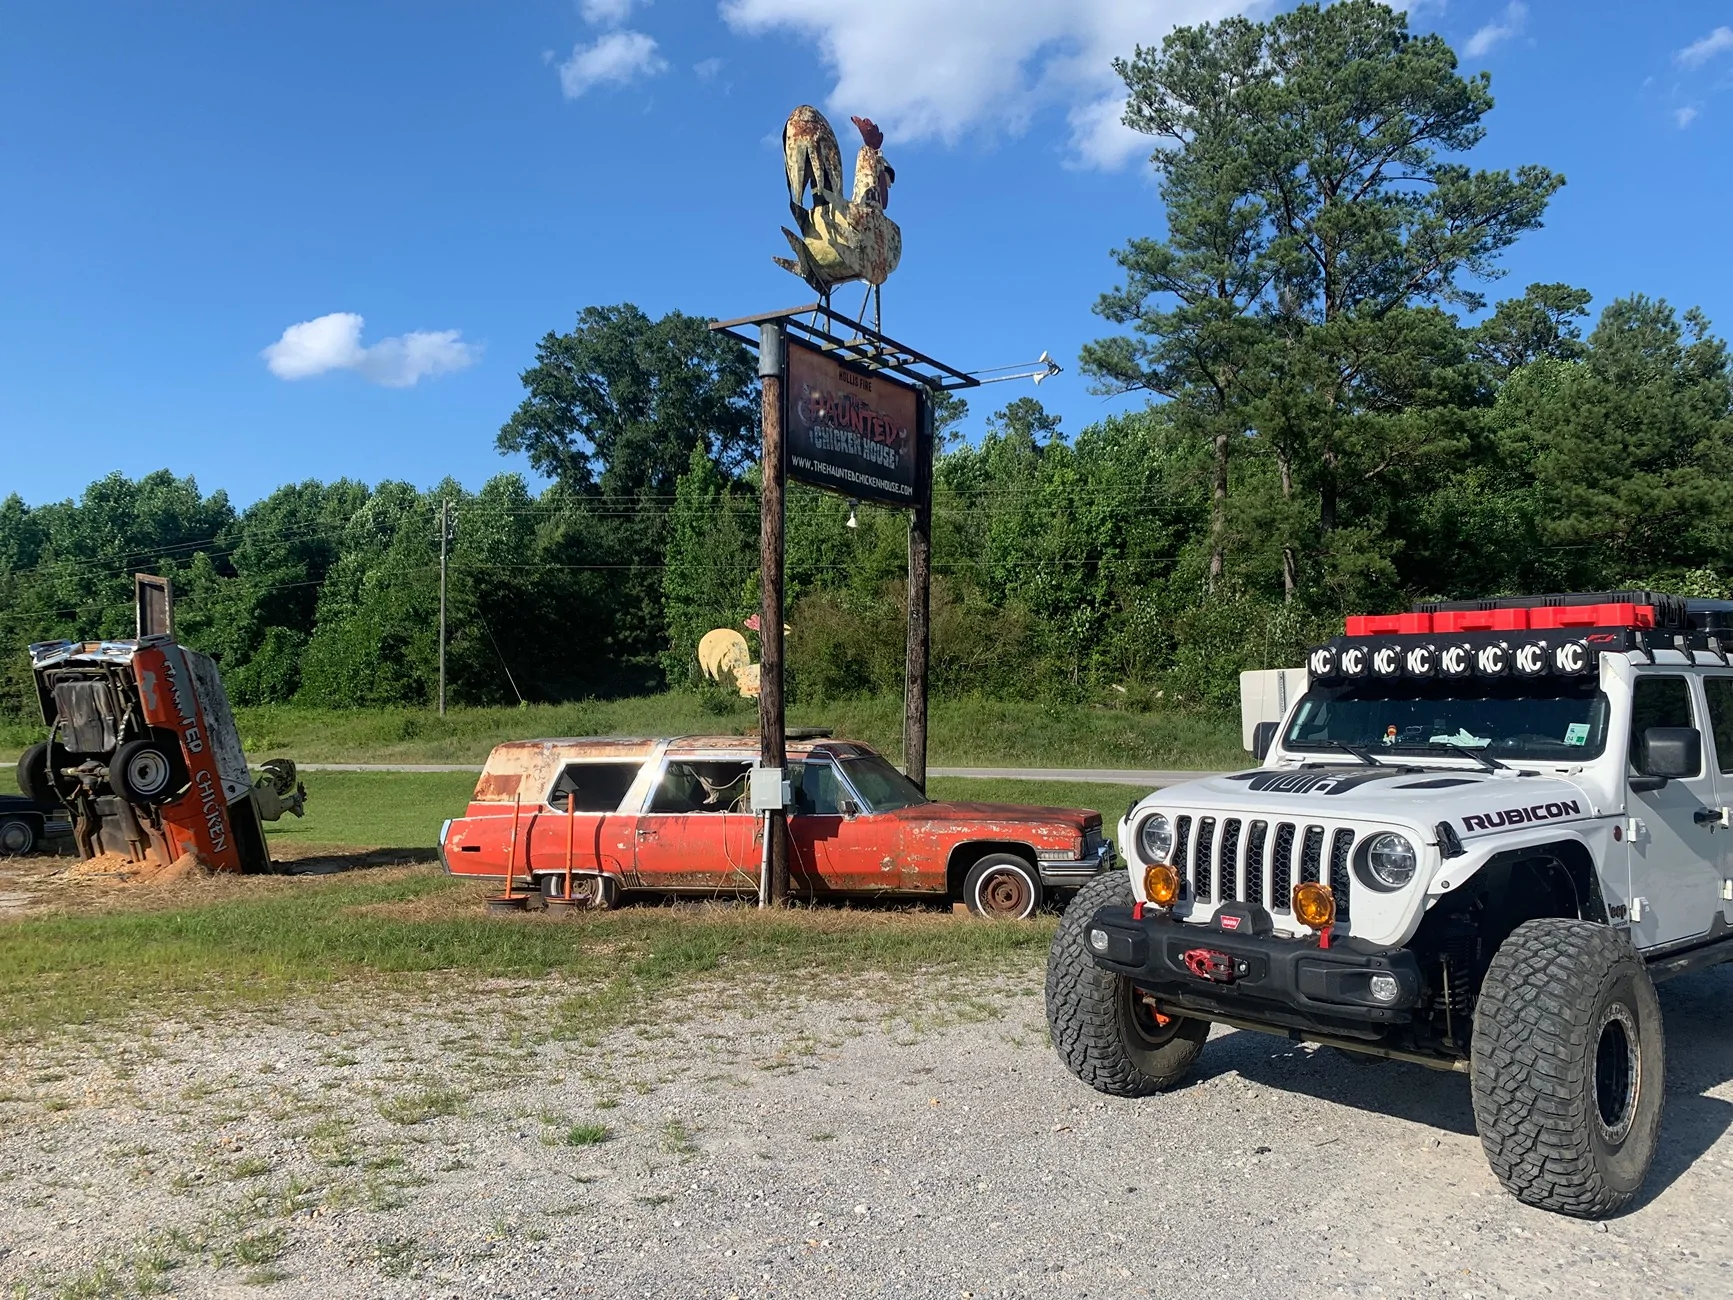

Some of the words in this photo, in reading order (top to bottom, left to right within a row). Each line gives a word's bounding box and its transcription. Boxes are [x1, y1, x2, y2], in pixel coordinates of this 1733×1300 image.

[838, 370, 859, 387] HOLLIS
[860, 378, 872, 392] FIRE
[809, 391, 898, 447] HAUNTED
[813, 425, 862, 456] CHICKEN
[862, 437, 896, 470] HOUSE
[791, 454, 914, 496] WWW.THEHAUNTEDCHICKENHOUSE.COM
[1311, 649, 1331, 674] KC
[1342, 648, 1362, 674] KC
[1374, 648, 1395, 674] KC
[1407, 647, 1429, 674] KC
[1442, 646, 1465, 673] KC
[1478, 646, 1502, 673] KC
[1516, 644, 1542, 672] KC
[1556, 643, 1583, 672] KC
[195, 770, 228, 853] CHICKEN
[1461, 800, 1581, 832] RUBICON
